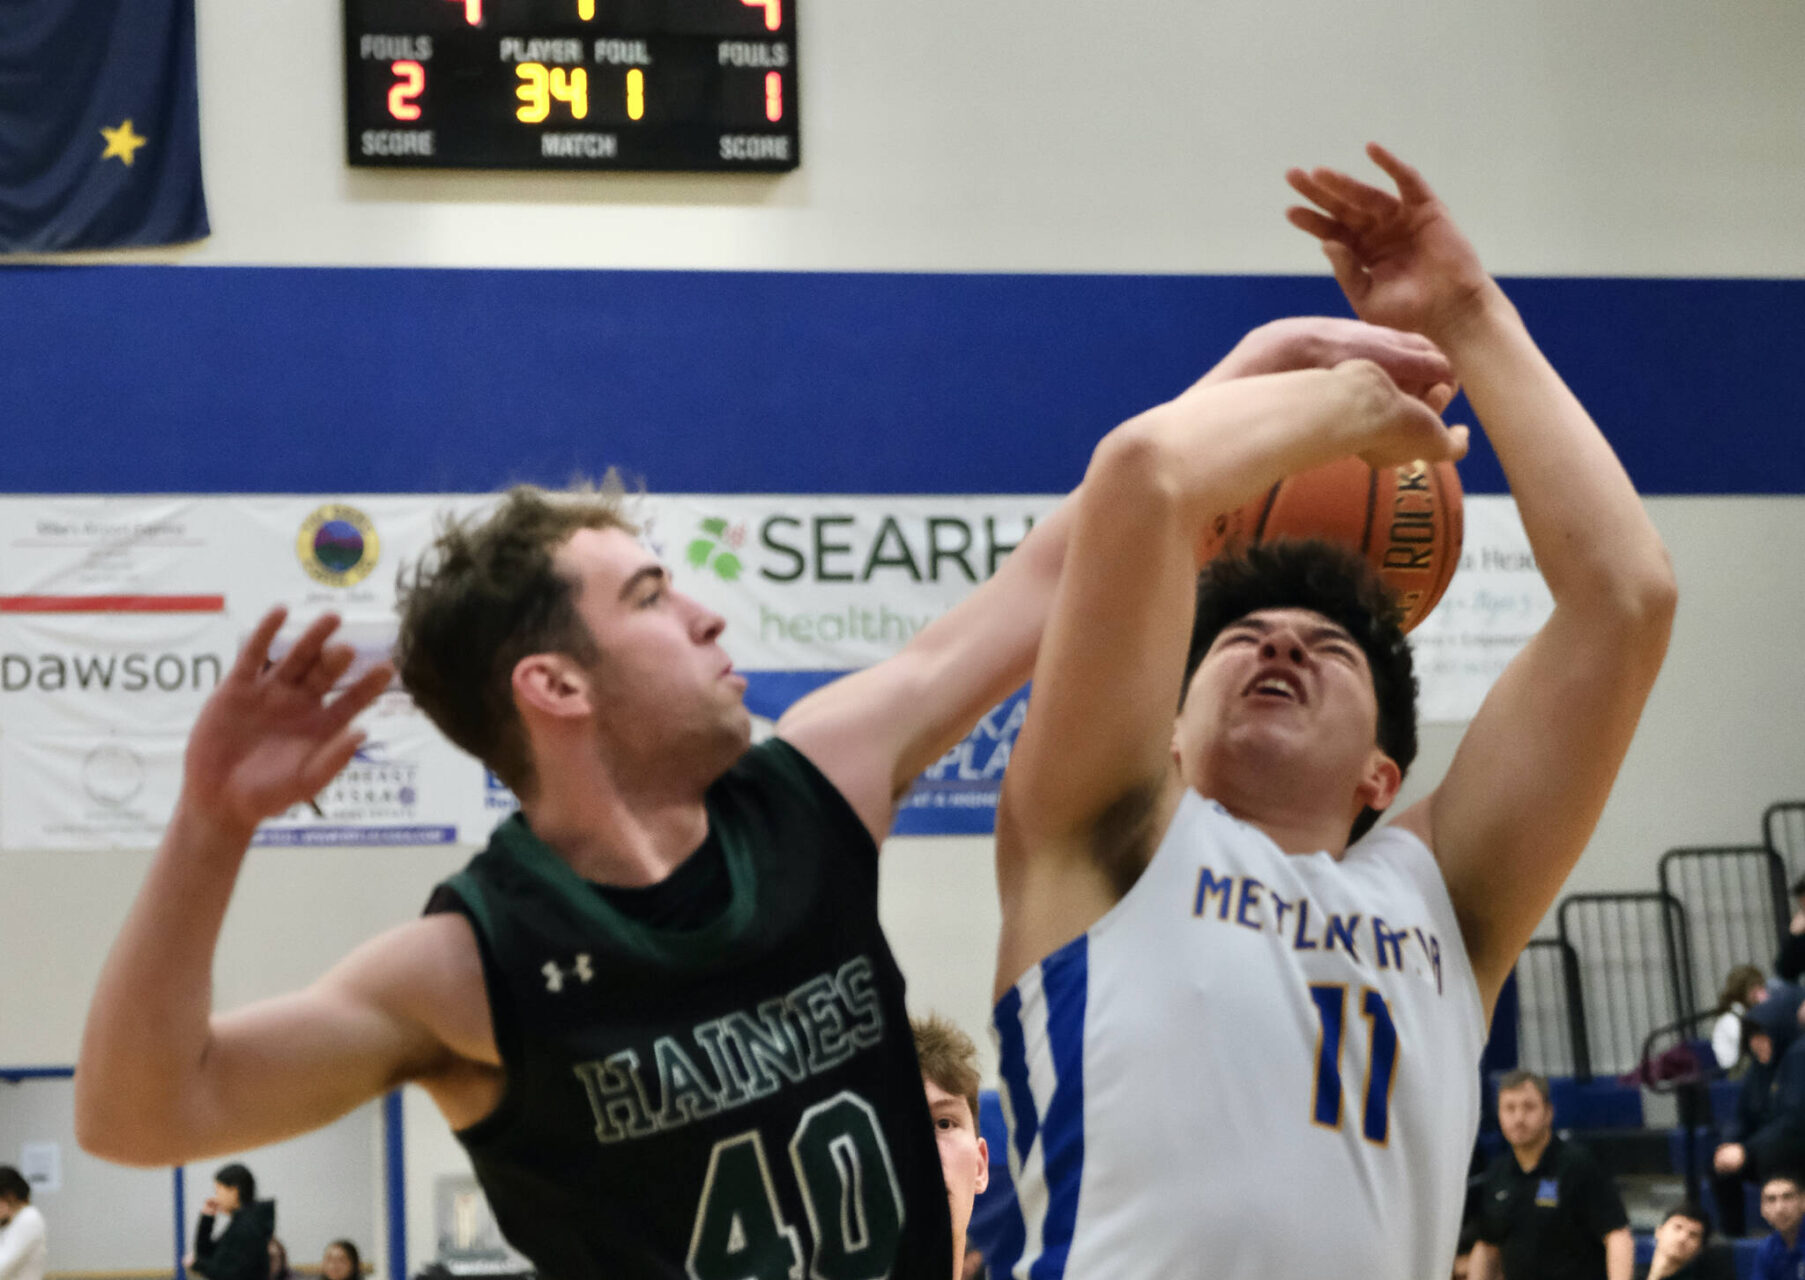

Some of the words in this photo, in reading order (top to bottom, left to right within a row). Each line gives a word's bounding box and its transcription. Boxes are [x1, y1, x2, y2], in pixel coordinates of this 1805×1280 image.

[361, 35, 432, 60] FOULS
[500, 38, 582, 63] PLAYER
[595, 39, 651, 65] FOUL
[719, 41, 787, 66] FOULS
[388, 60, 425, 121] 2
[515, 61, 588, 123] 34
[626, 68, 644, 121] 1
[765, 71, 782, 122] 1
[362, 131, 434, 157] SCORE
[541, 132, 617, 157] MATCH
[720, 134, 788, 161] SCORE
[574, 955, 884, 1143] HAINES
[1307, 980, 1401, 1150] 11
